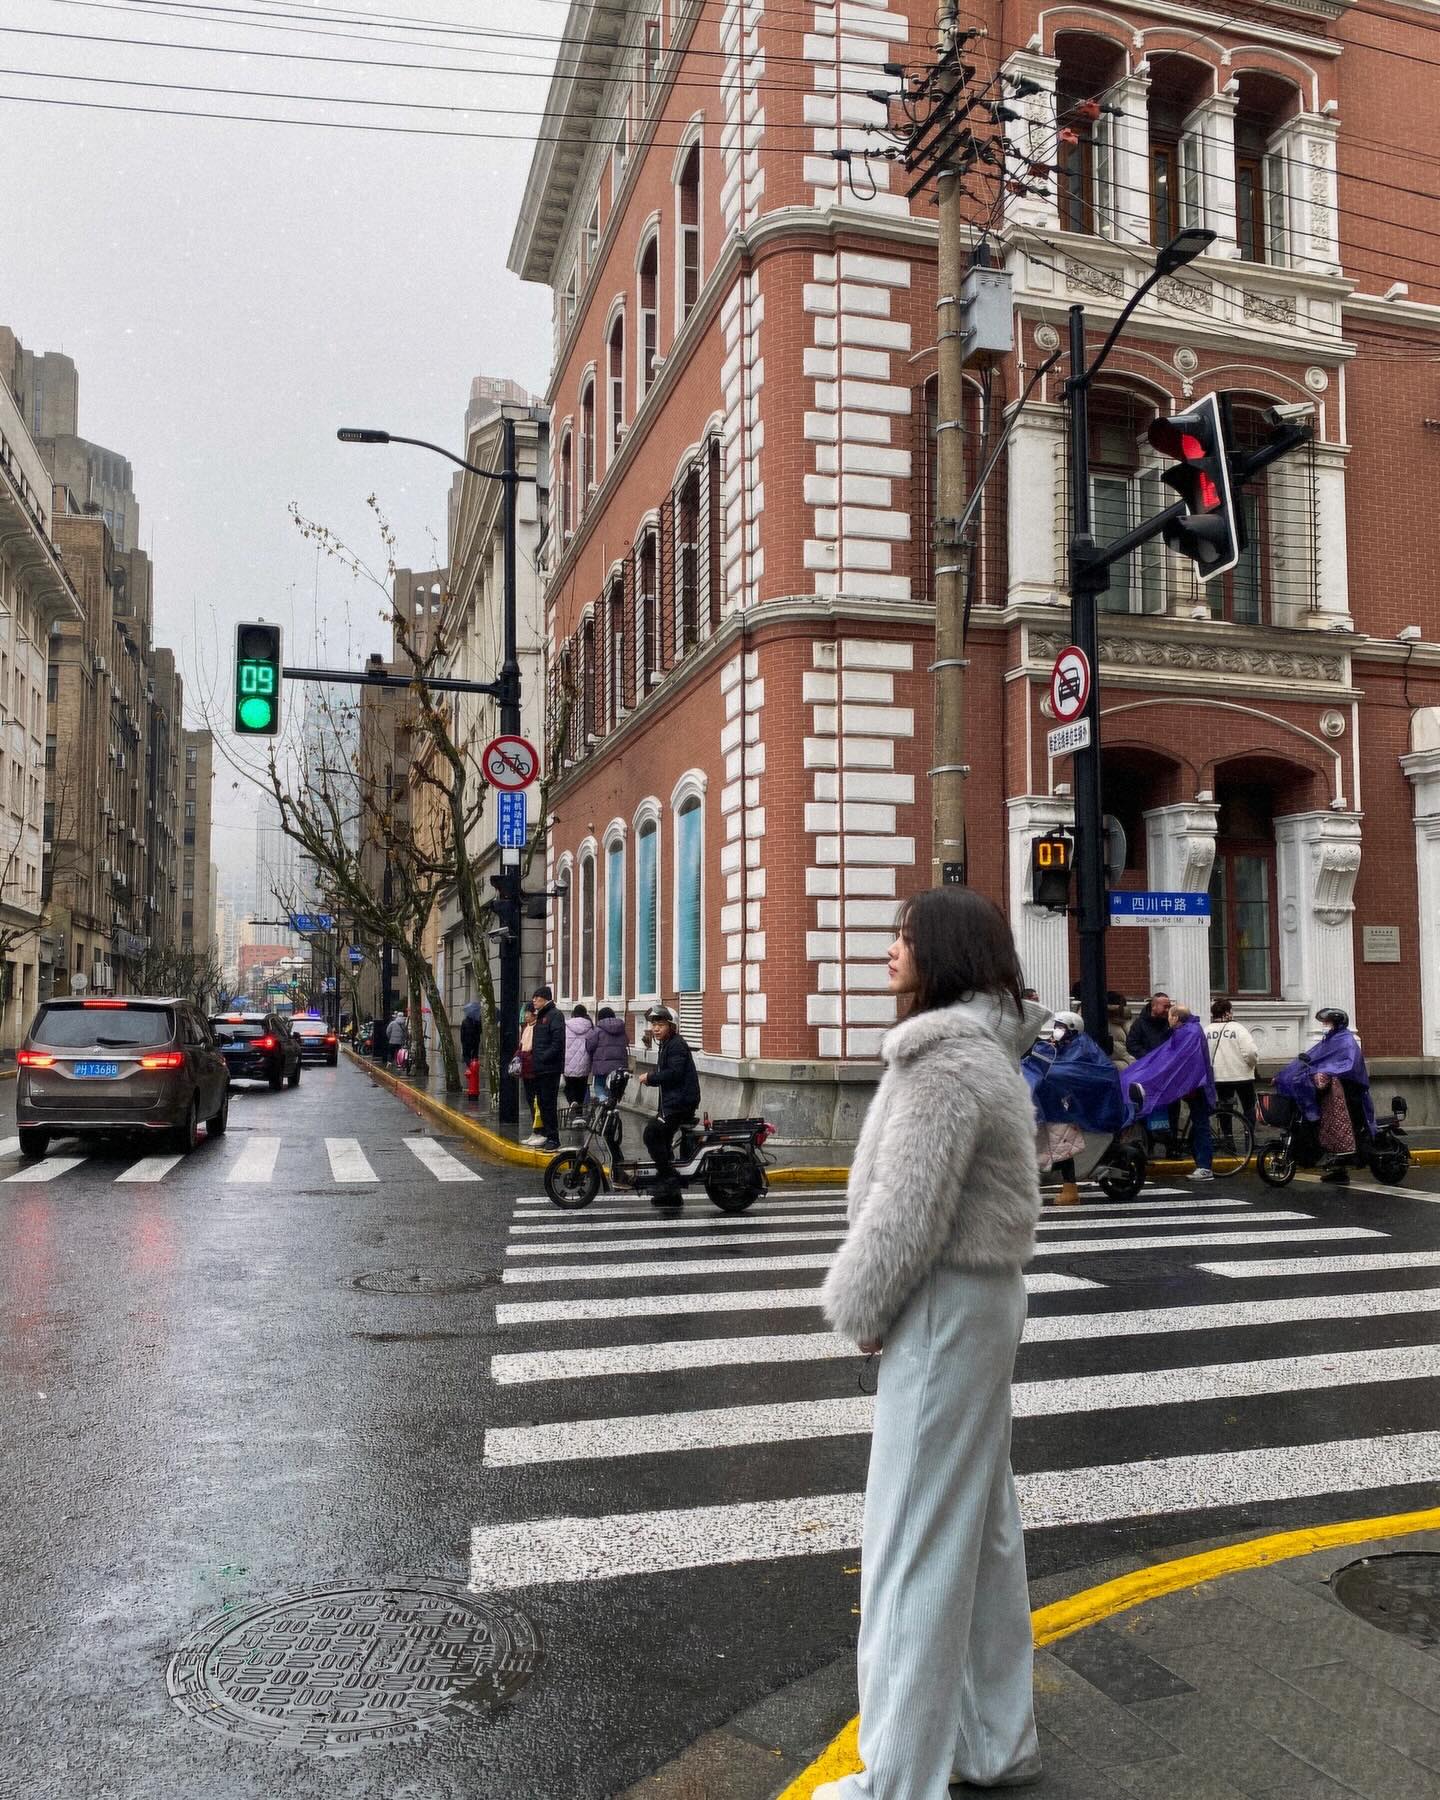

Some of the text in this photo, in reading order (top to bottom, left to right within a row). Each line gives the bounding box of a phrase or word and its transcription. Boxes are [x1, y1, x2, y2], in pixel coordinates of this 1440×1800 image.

[242, 665, 273, 693] 09
[1039, 843, 1065, 865] 07
[1113, 896, 1205, 912] 南 四川中路 北
[1115, 916, 1121, 924] S
[1207, 1030, 1237, 1040] ADCA
